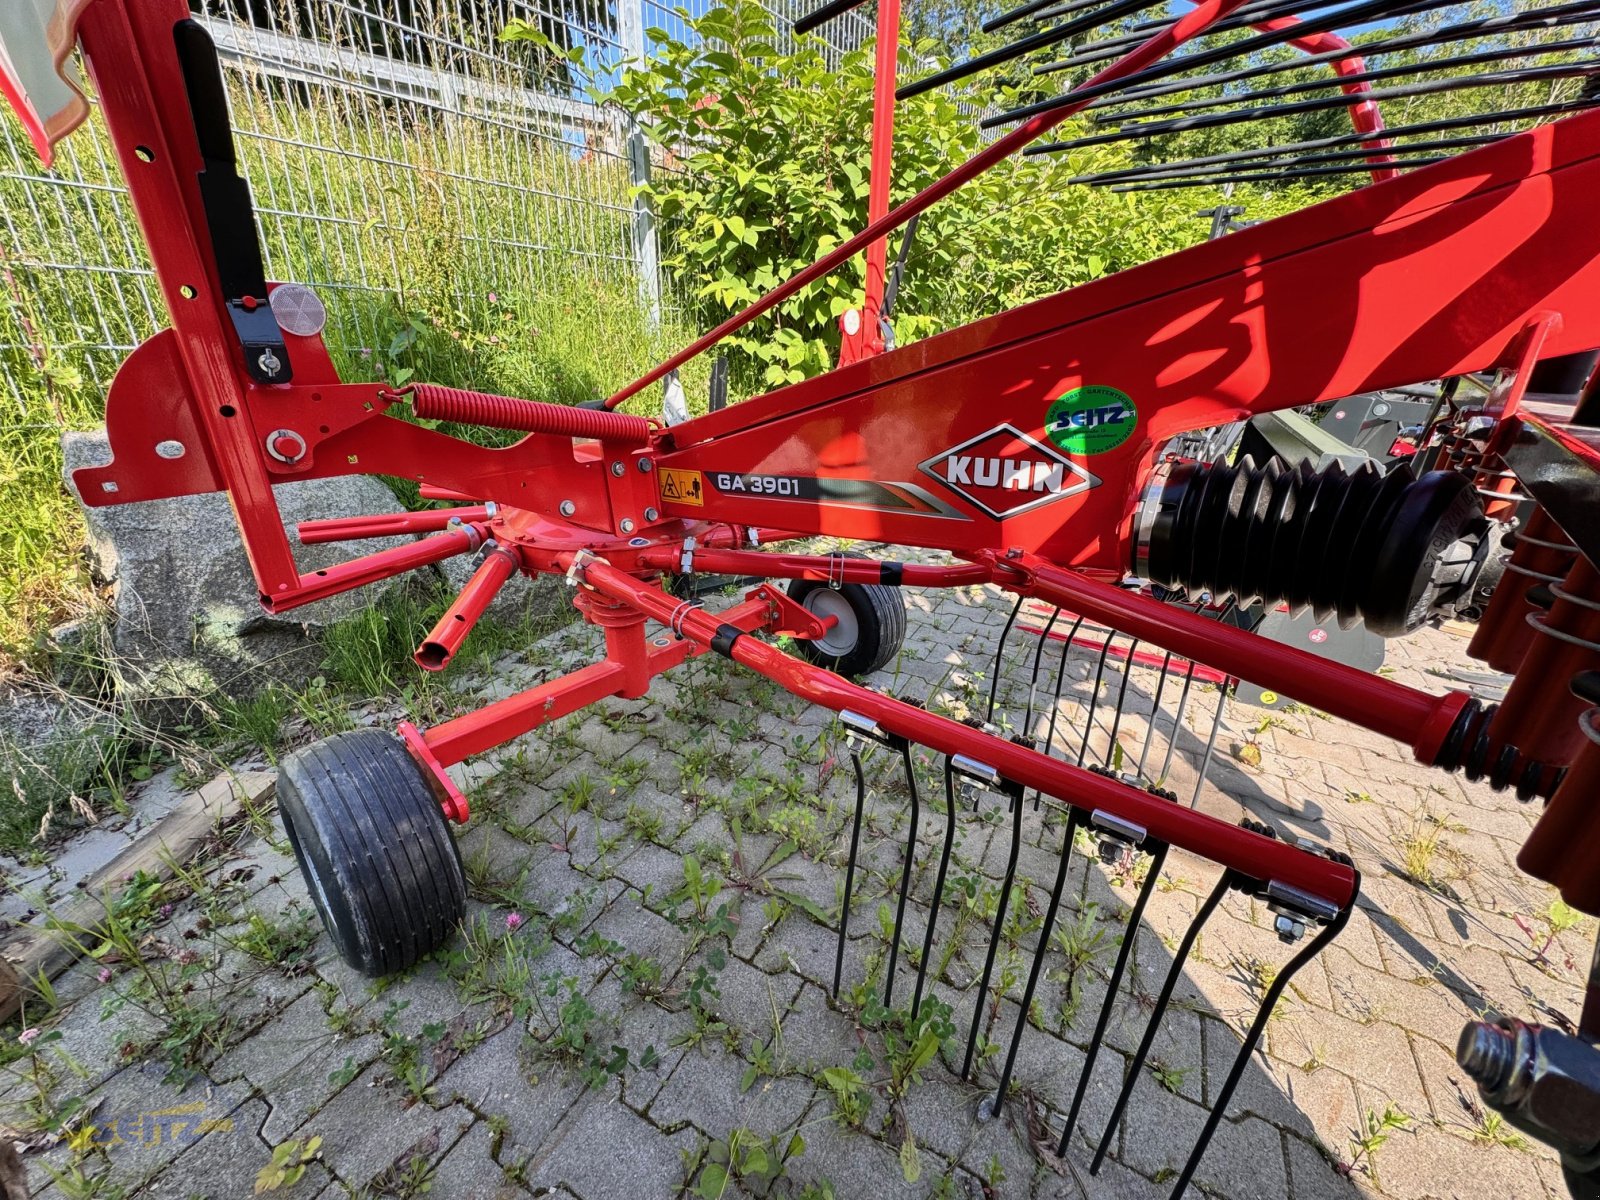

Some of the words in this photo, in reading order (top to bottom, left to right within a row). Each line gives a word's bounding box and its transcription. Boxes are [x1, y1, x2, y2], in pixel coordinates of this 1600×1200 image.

[1056, 406, 1124, 429] SEITZ
[718, 474, 746, 491] GA
[750, 477, 799, 495] 3901
[947, 455, 1064, 494] KUHN
